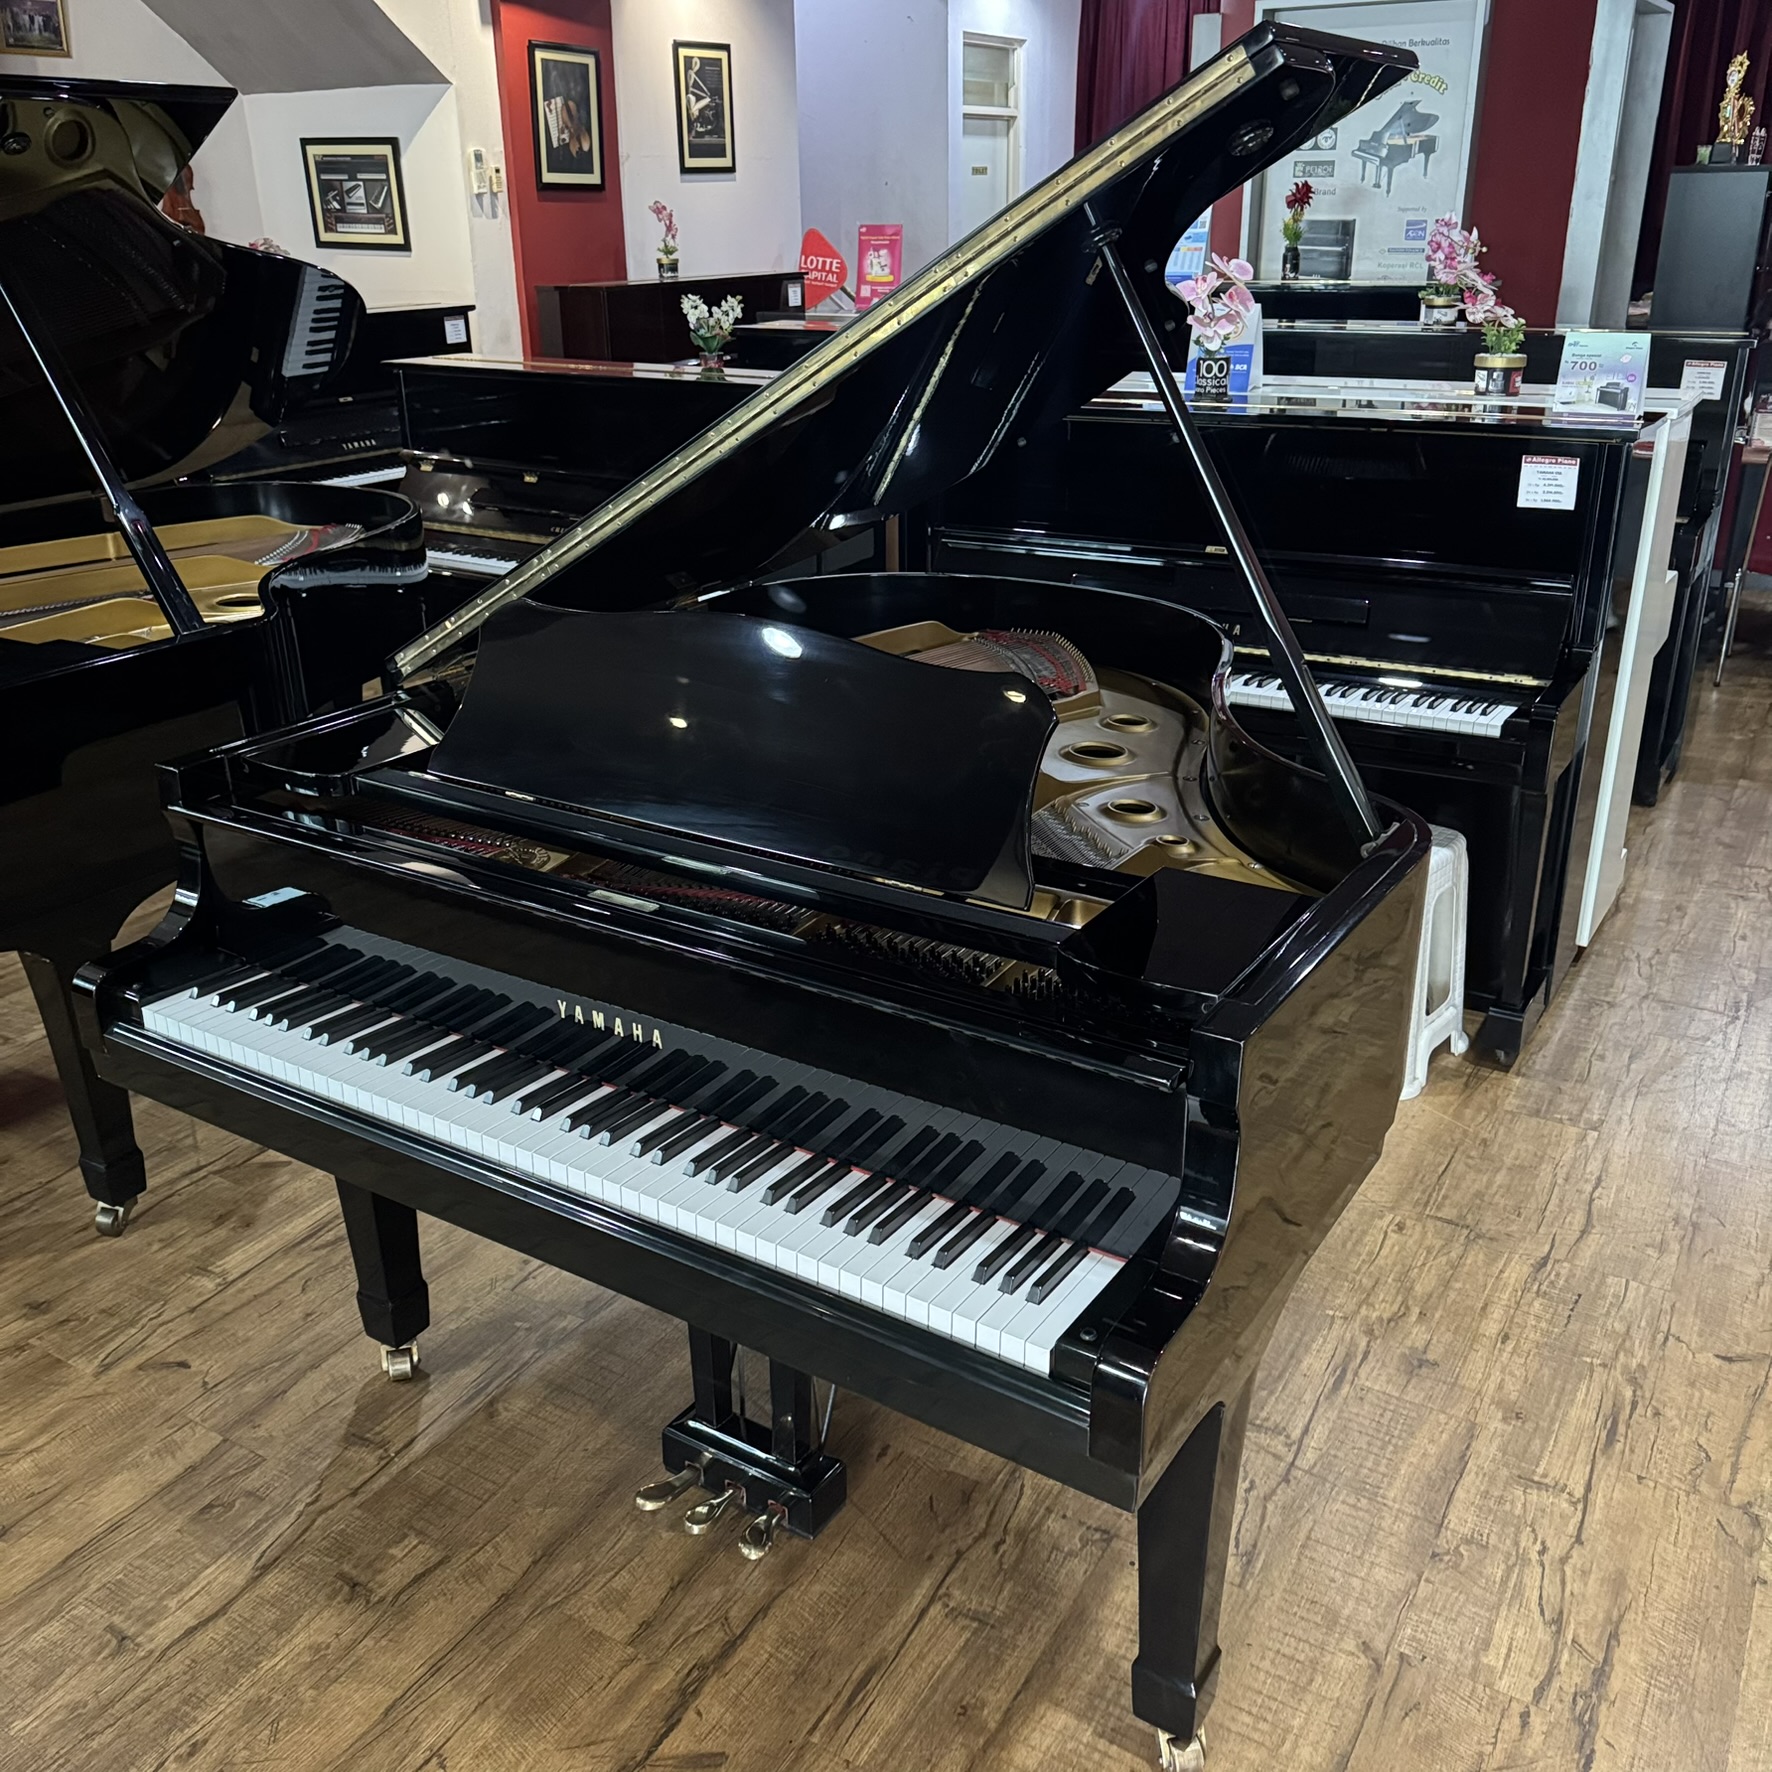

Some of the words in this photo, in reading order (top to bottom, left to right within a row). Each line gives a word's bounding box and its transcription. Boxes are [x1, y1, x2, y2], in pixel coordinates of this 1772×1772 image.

[1408, 37, 1450, 48] Berkualitas
[1409, 70, 1449, 96] Credit
[1314, 188, 1337, 196] Brand
[800, 254, 841, 272] LOTTE
[800, 269, 839, 283] APITAL
[1199, 359, 1228, 378] 100
[1570, 360, 1598, 371] 700
[1196, 374, 1229, 387] lassical
[1205, 386, 1226, 394] Pieces
[1531, 456, 1557, 465] Allegro
[557, 999, 663, 1050] YAMAHA
